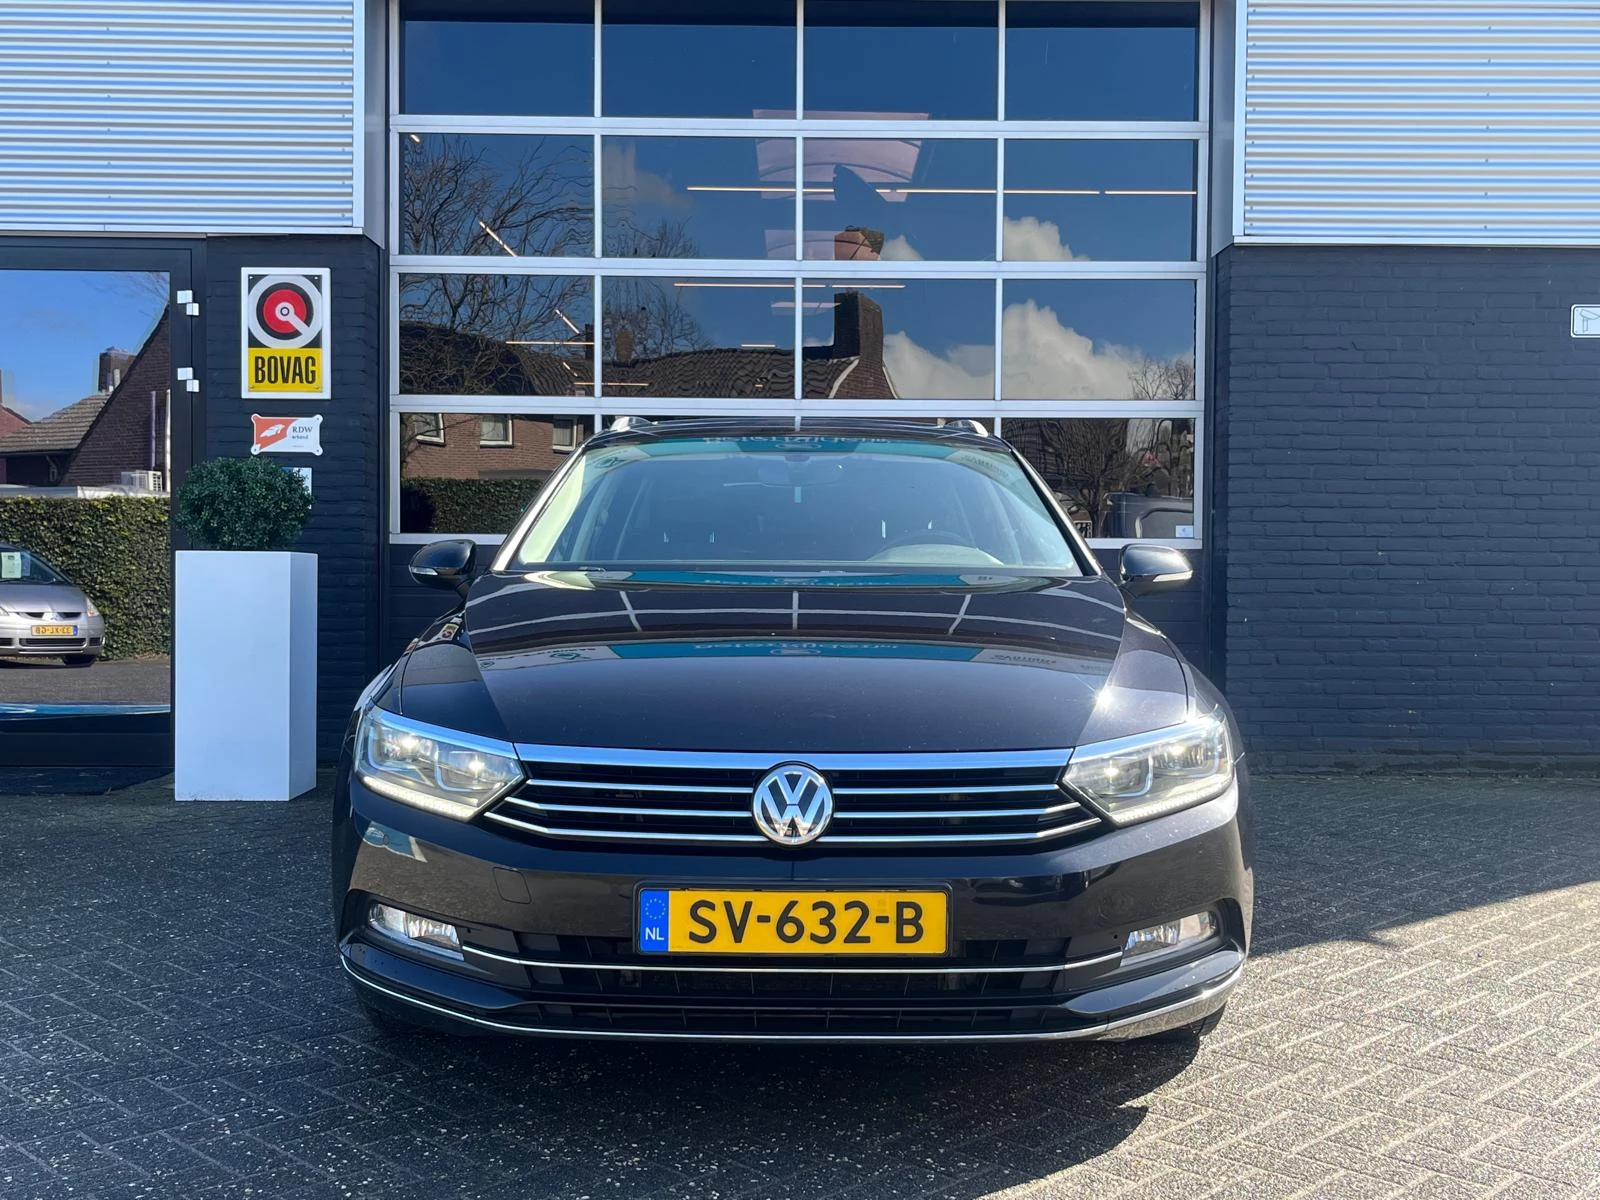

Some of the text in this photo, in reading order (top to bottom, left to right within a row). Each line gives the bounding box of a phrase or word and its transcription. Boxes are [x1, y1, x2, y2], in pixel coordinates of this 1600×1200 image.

[254, 355, 317, 385] BOVAG
[645, 927, 665, 941] NL
[688, 899, 924, 944] SV-632-B
